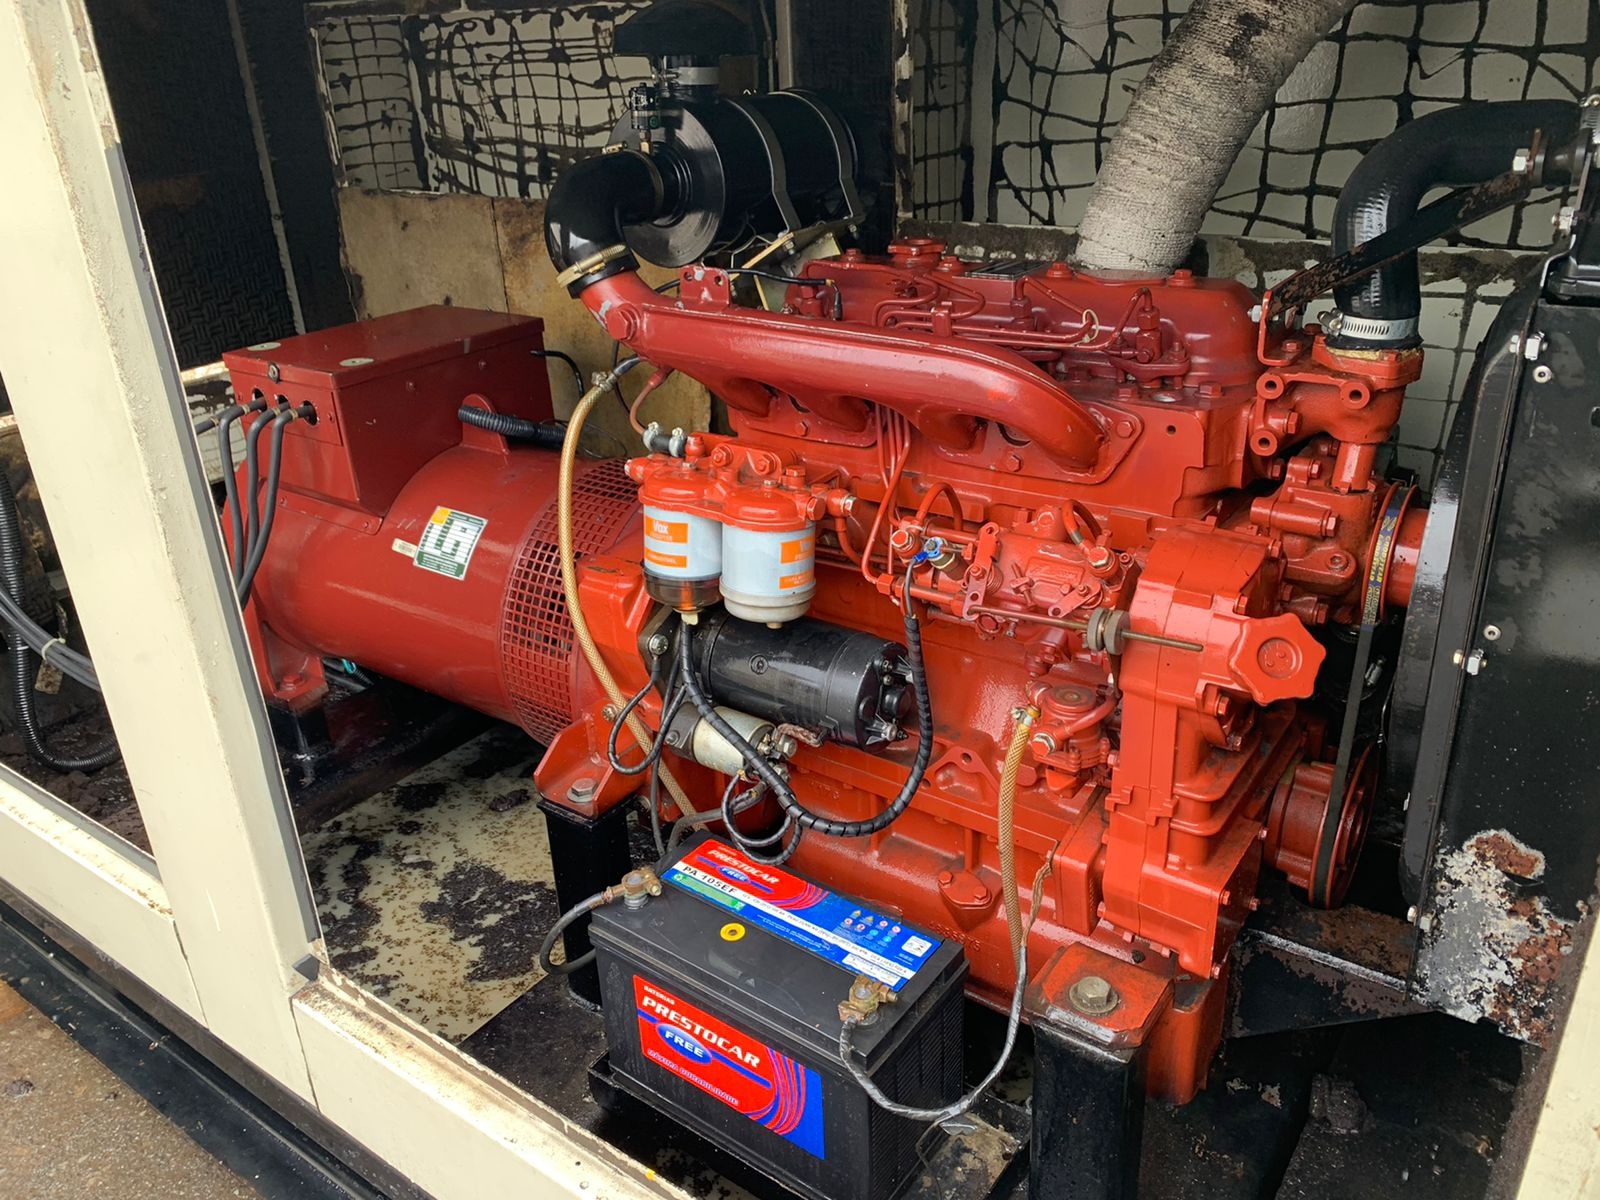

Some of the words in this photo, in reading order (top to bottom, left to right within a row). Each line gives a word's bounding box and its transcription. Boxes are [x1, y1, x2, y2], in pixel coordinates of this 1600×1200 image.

[1376, 535, 1391, 583] GOODYEAR
[682, 865, 697, 877] PA
[701, 873, 738, 894] 105EF
[708, 849, 780, 884] PRESTOCAR
[721, 867, 749, 882] FREE
[642, 996, 761, 1068] PRESTOCAR
[664, 1030, 705, 1059] FREE
